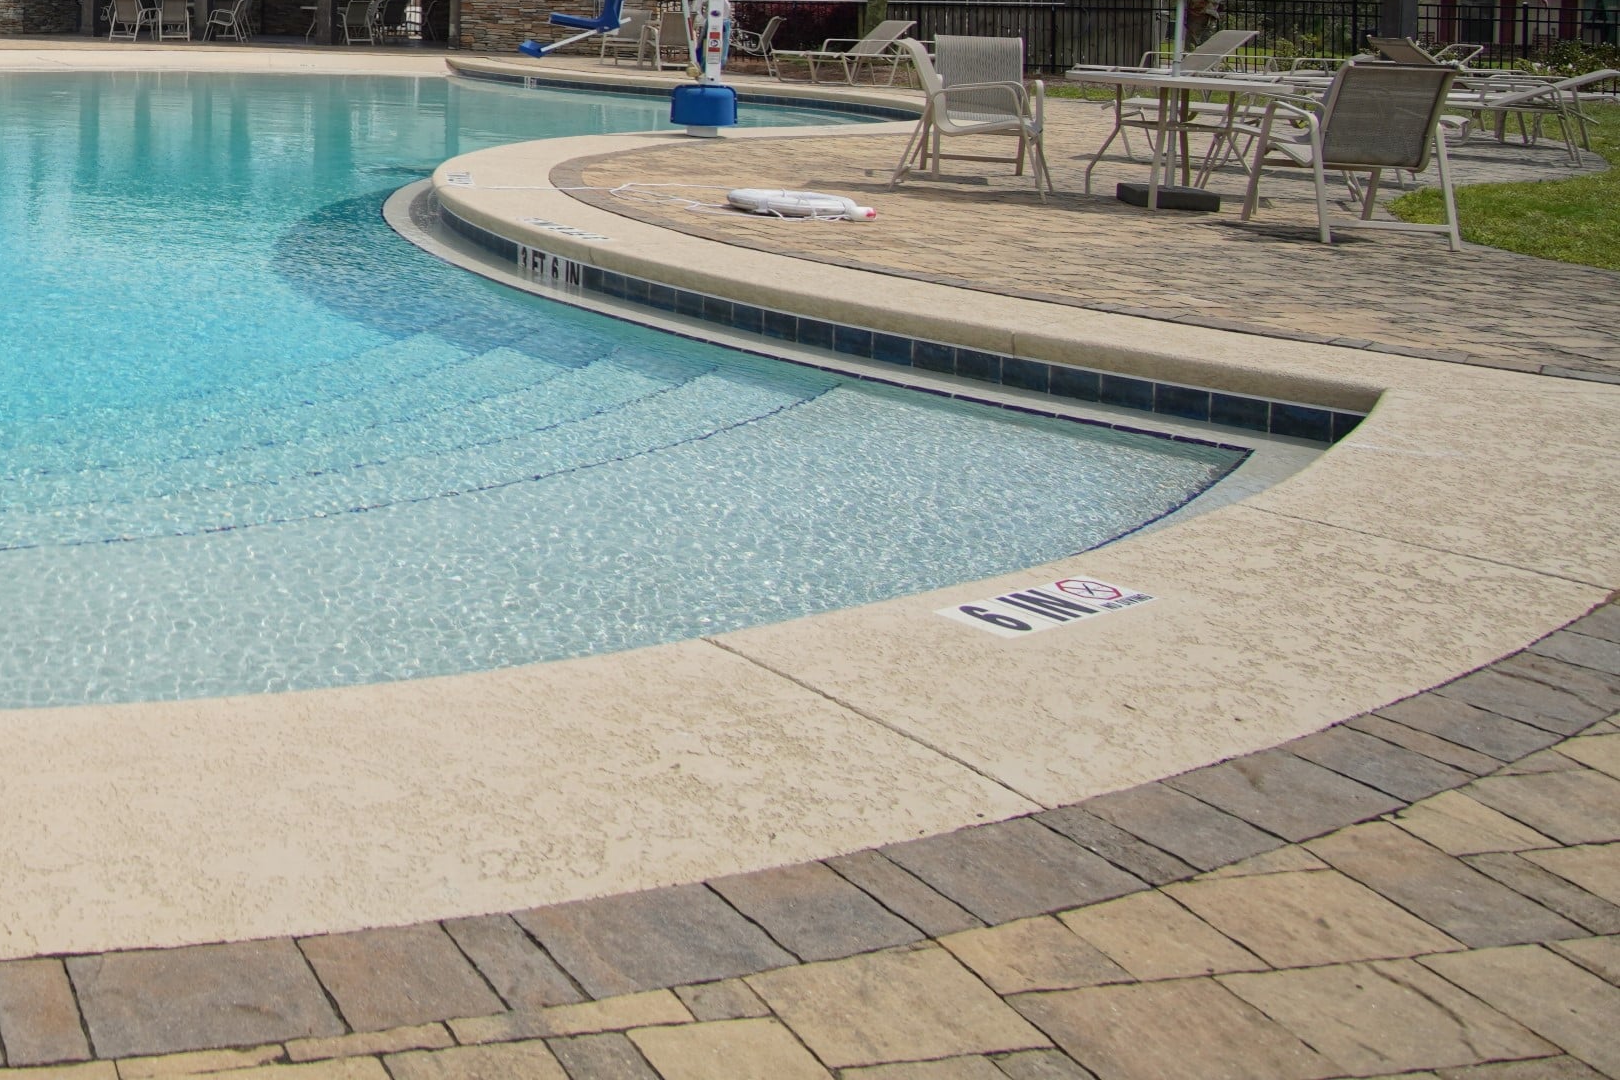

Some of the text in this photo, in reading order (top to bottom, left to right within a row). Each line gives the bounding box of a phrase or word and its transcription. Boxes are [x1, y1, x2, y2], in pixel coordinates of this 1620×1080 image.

[521, 246, 580, 286] 3 FT 6 IN
[958, 589, 1100, 631] 6 IN
